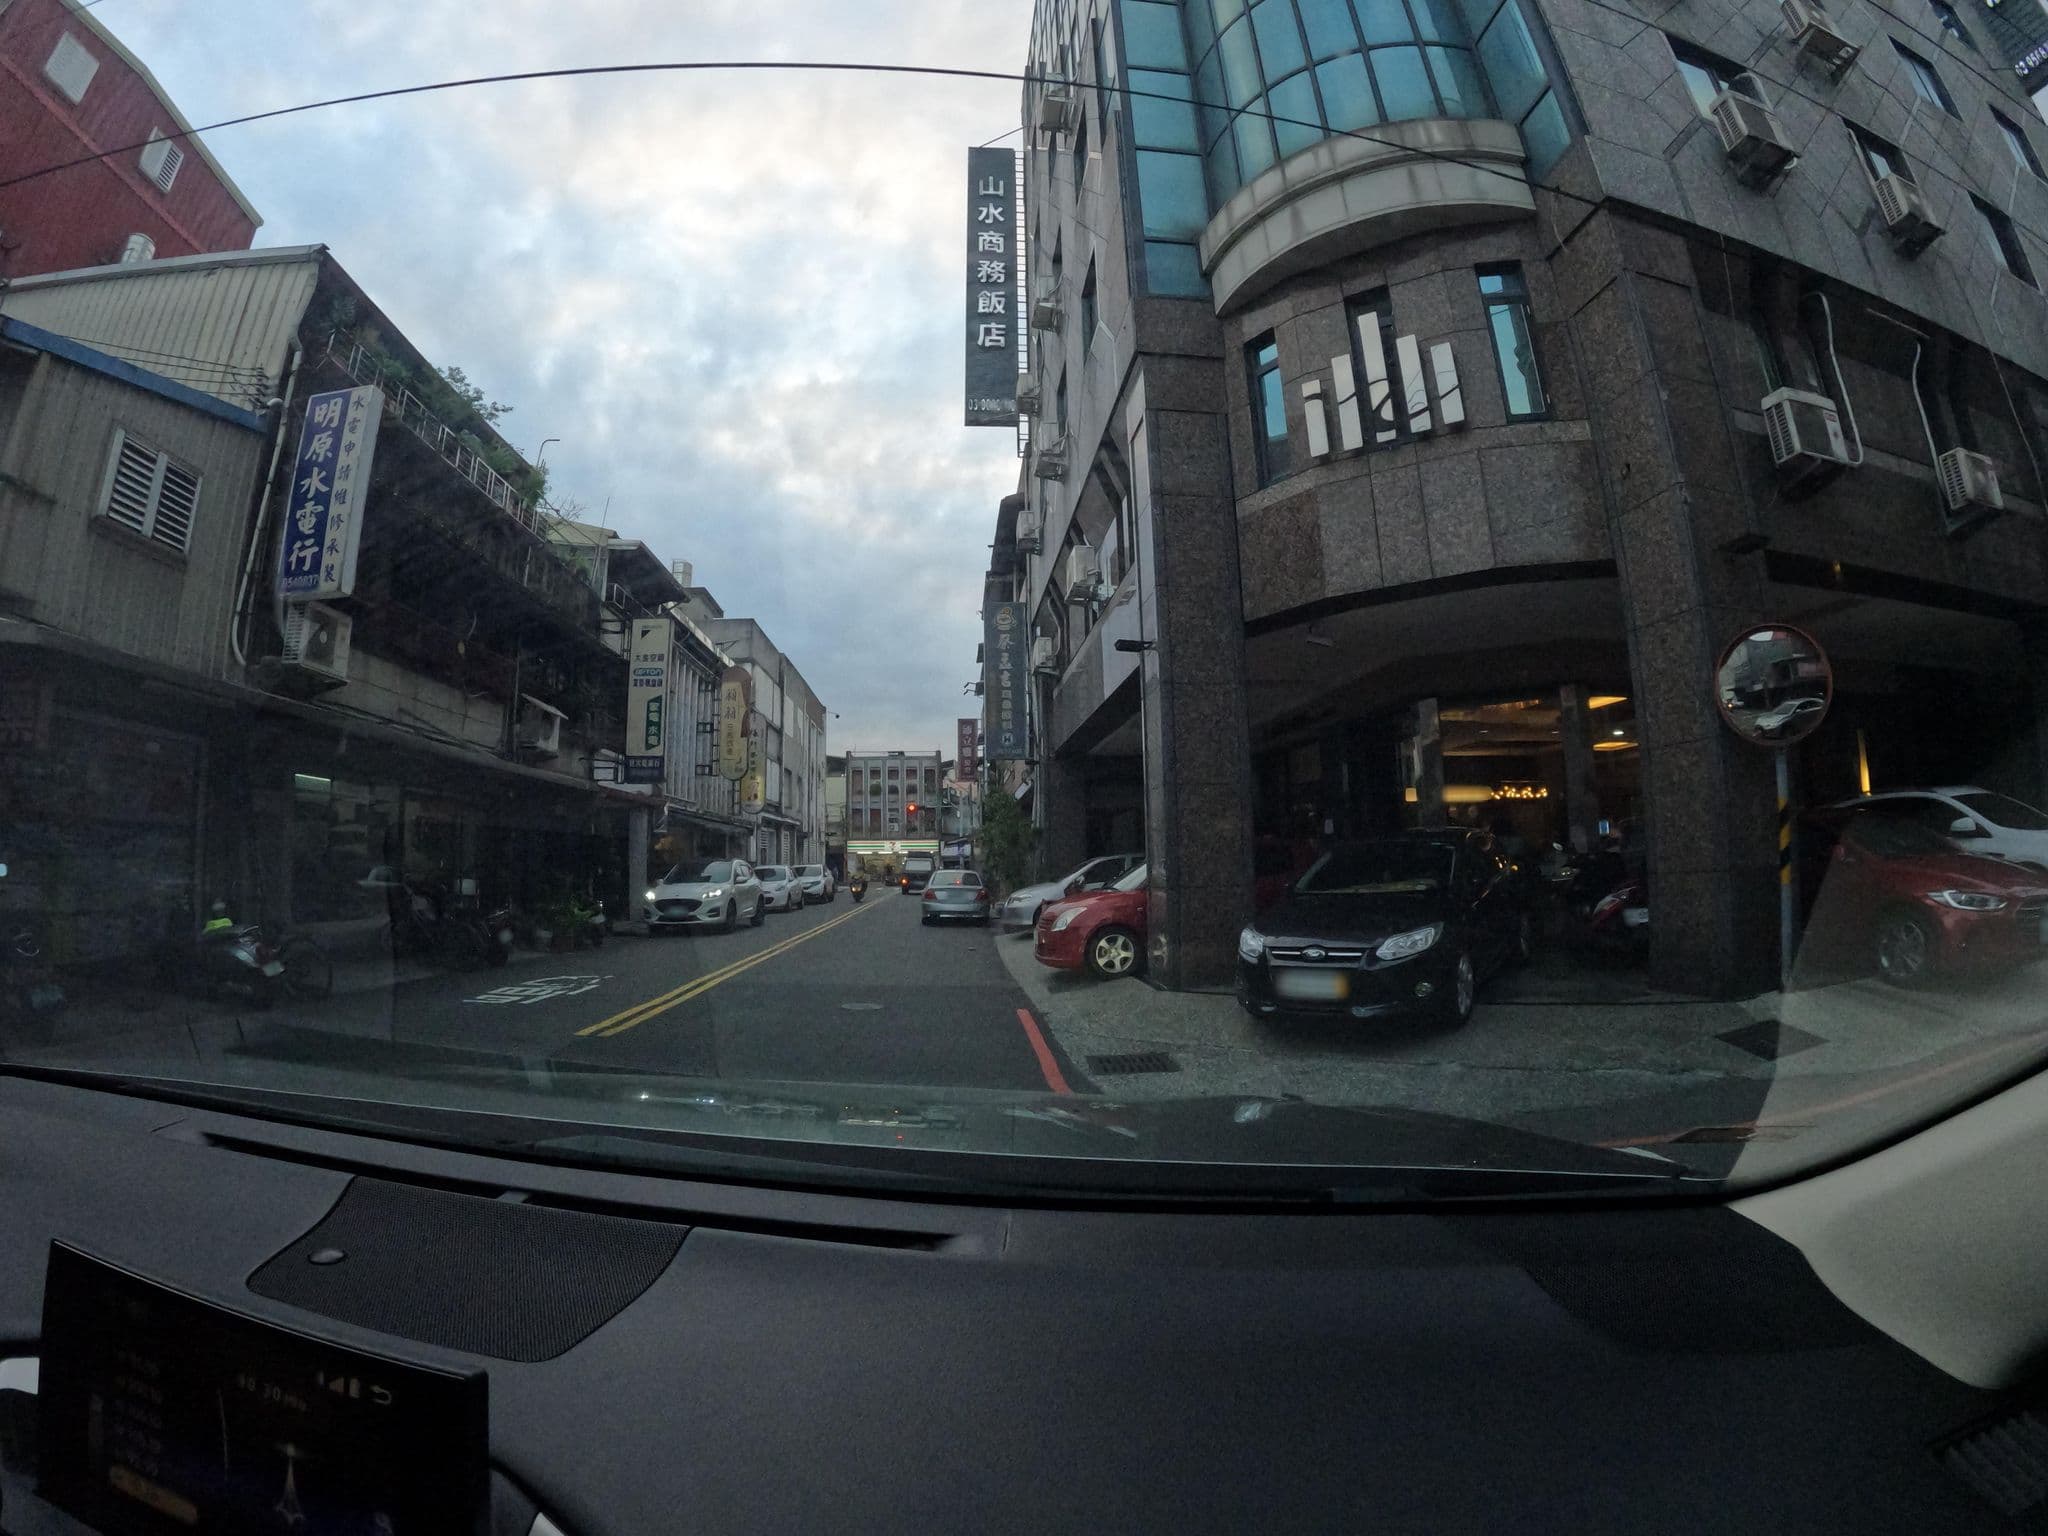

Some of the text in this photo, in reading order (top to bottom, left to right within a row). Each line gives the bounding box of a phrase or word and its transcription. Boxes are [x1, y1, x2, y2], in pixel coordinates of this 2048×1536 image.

[977, 175, 1006, 347] 山水商務飯店
[288, 397, 343, 572] 明原水電行
